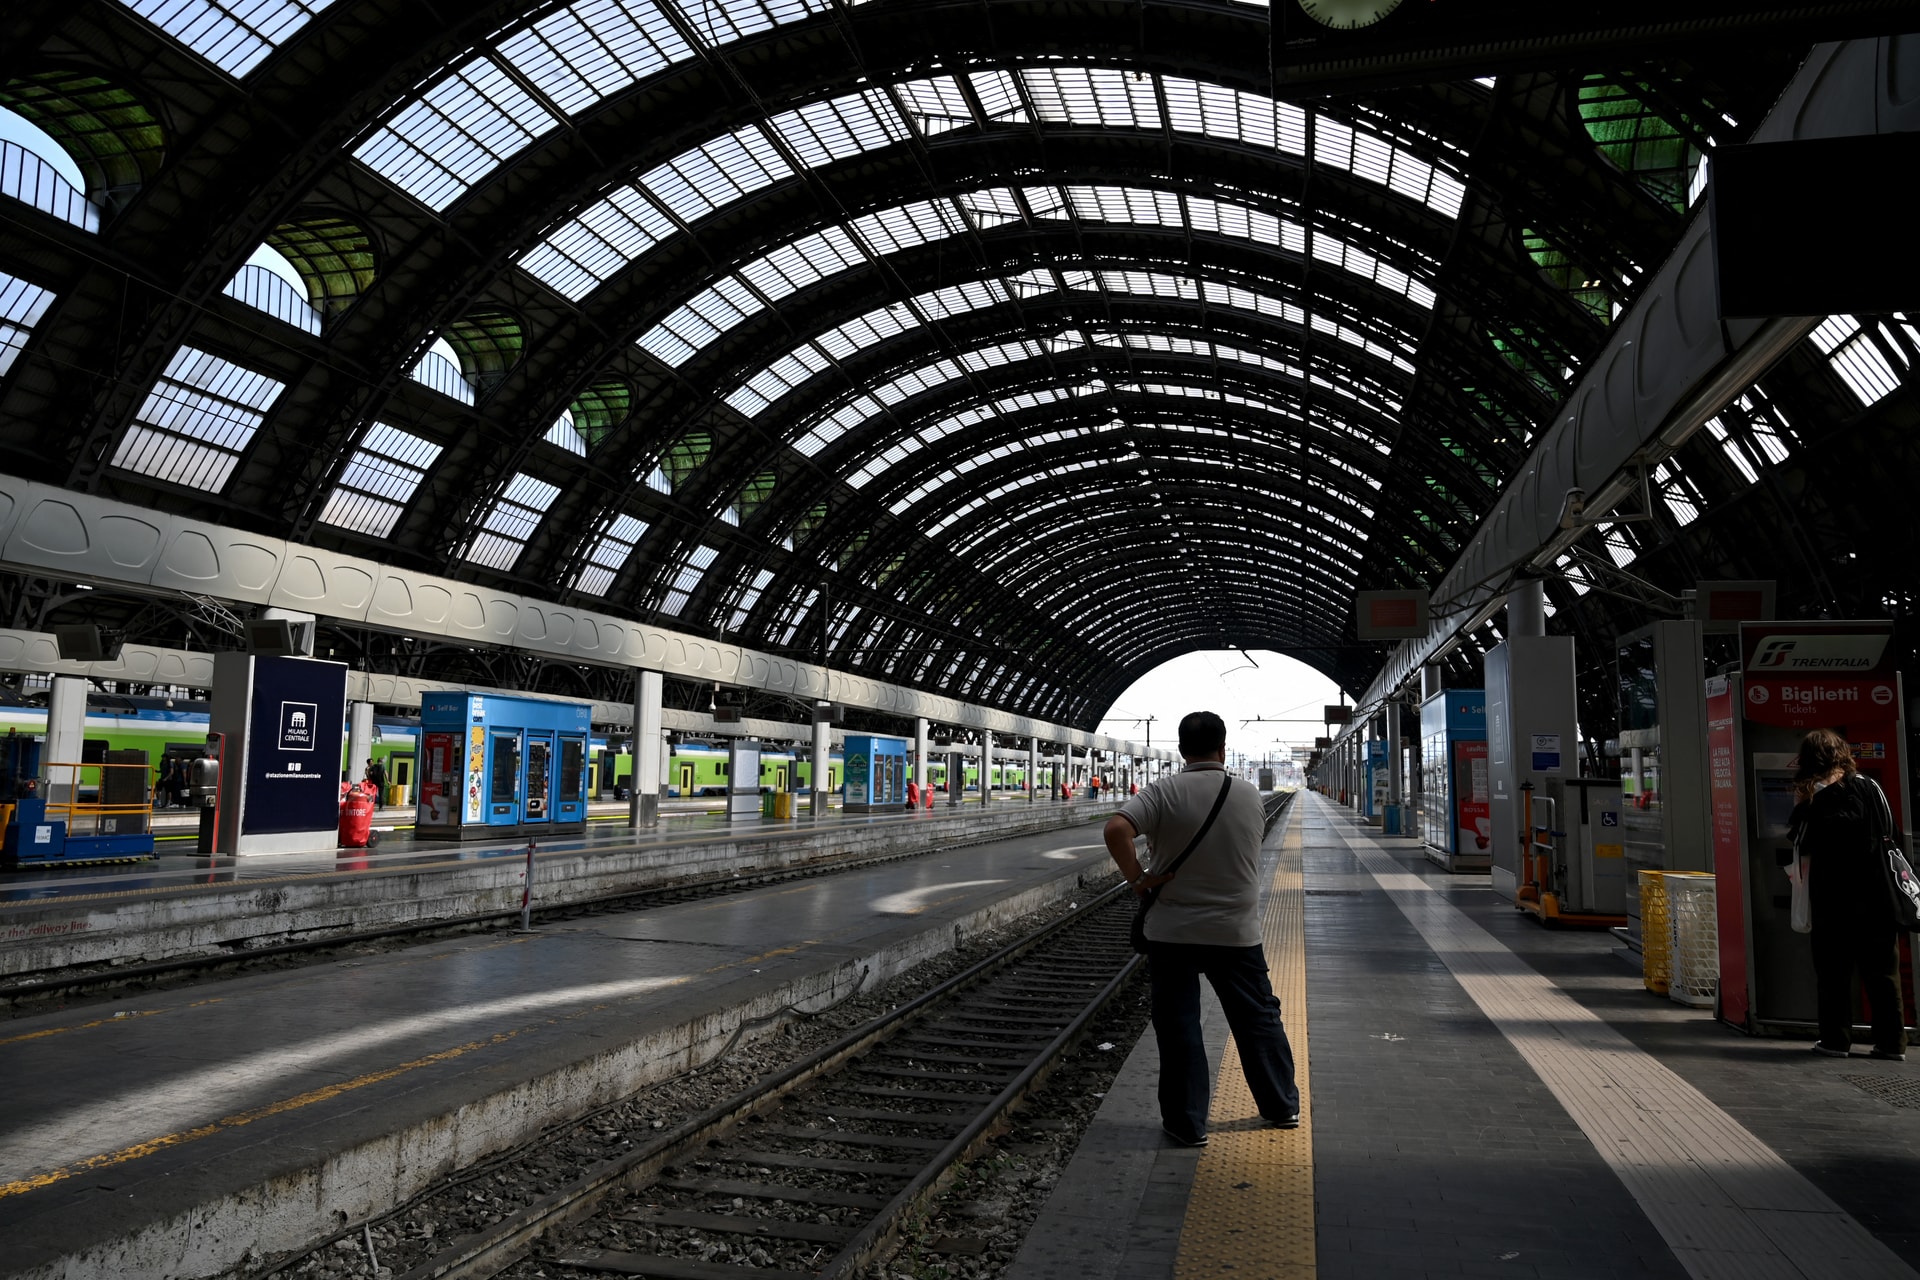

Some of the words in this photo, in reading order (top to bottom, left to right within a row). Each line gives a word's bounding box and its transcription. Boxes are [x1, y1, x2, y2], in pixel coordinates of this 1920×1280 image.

[1792, 658, 1870, 667] TRENITALIA
[1781, 685, 1859, 704] Biglietti
[1783, 703, 1817, 714] Tickets
[8, 927, 25, 937] the
[28, 924, 68, 935] railway
